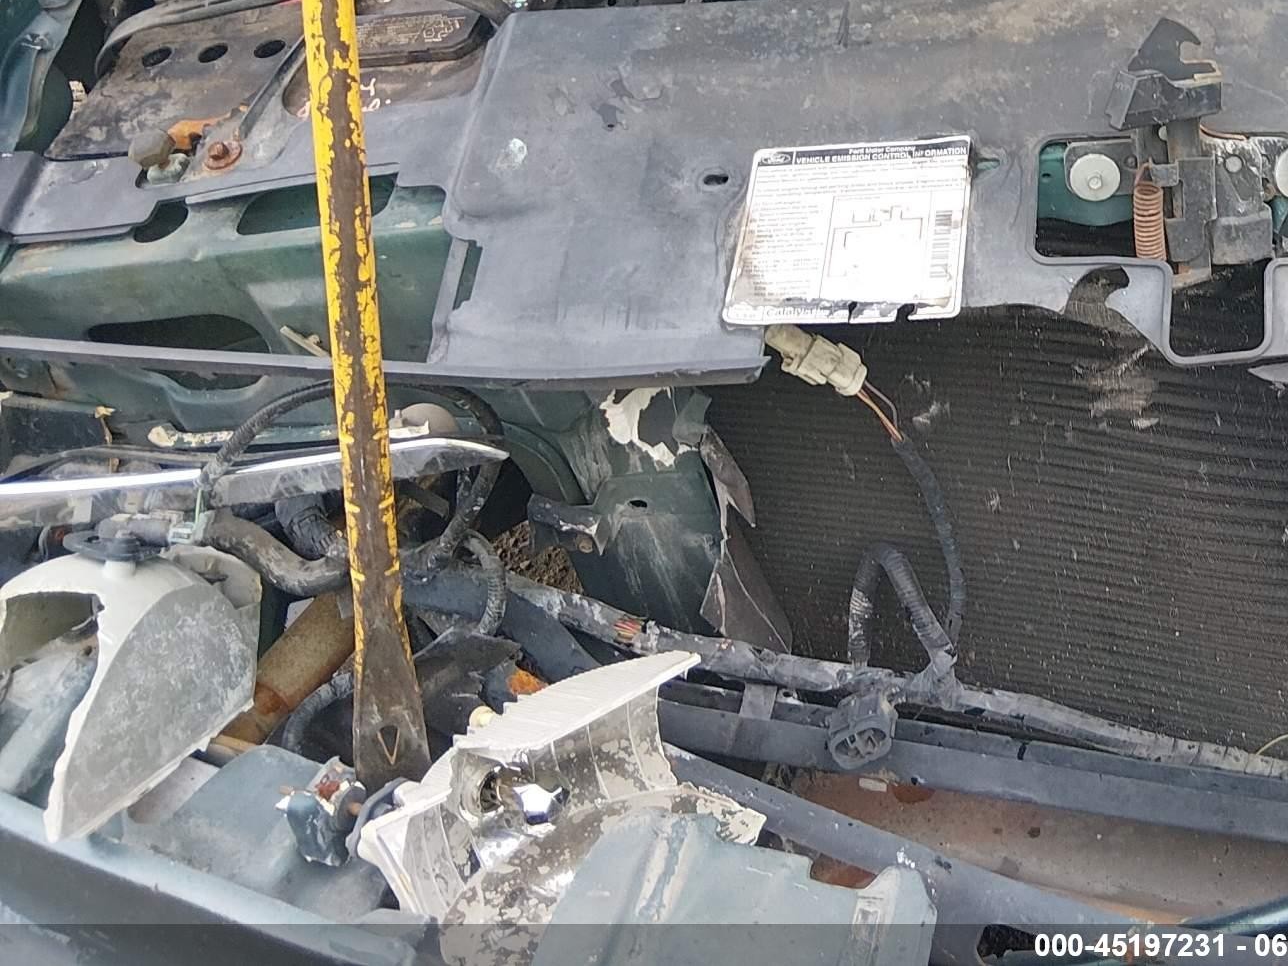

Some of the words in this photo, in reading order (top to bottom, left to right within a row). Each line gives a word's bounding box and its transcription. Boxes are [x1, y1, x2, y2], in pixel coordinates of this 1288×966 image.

[796, 156, 830, 164] VEHICLE
[831, 154, 870, 163] EMISSION
[872, 152, 911, 160] CONTROL
